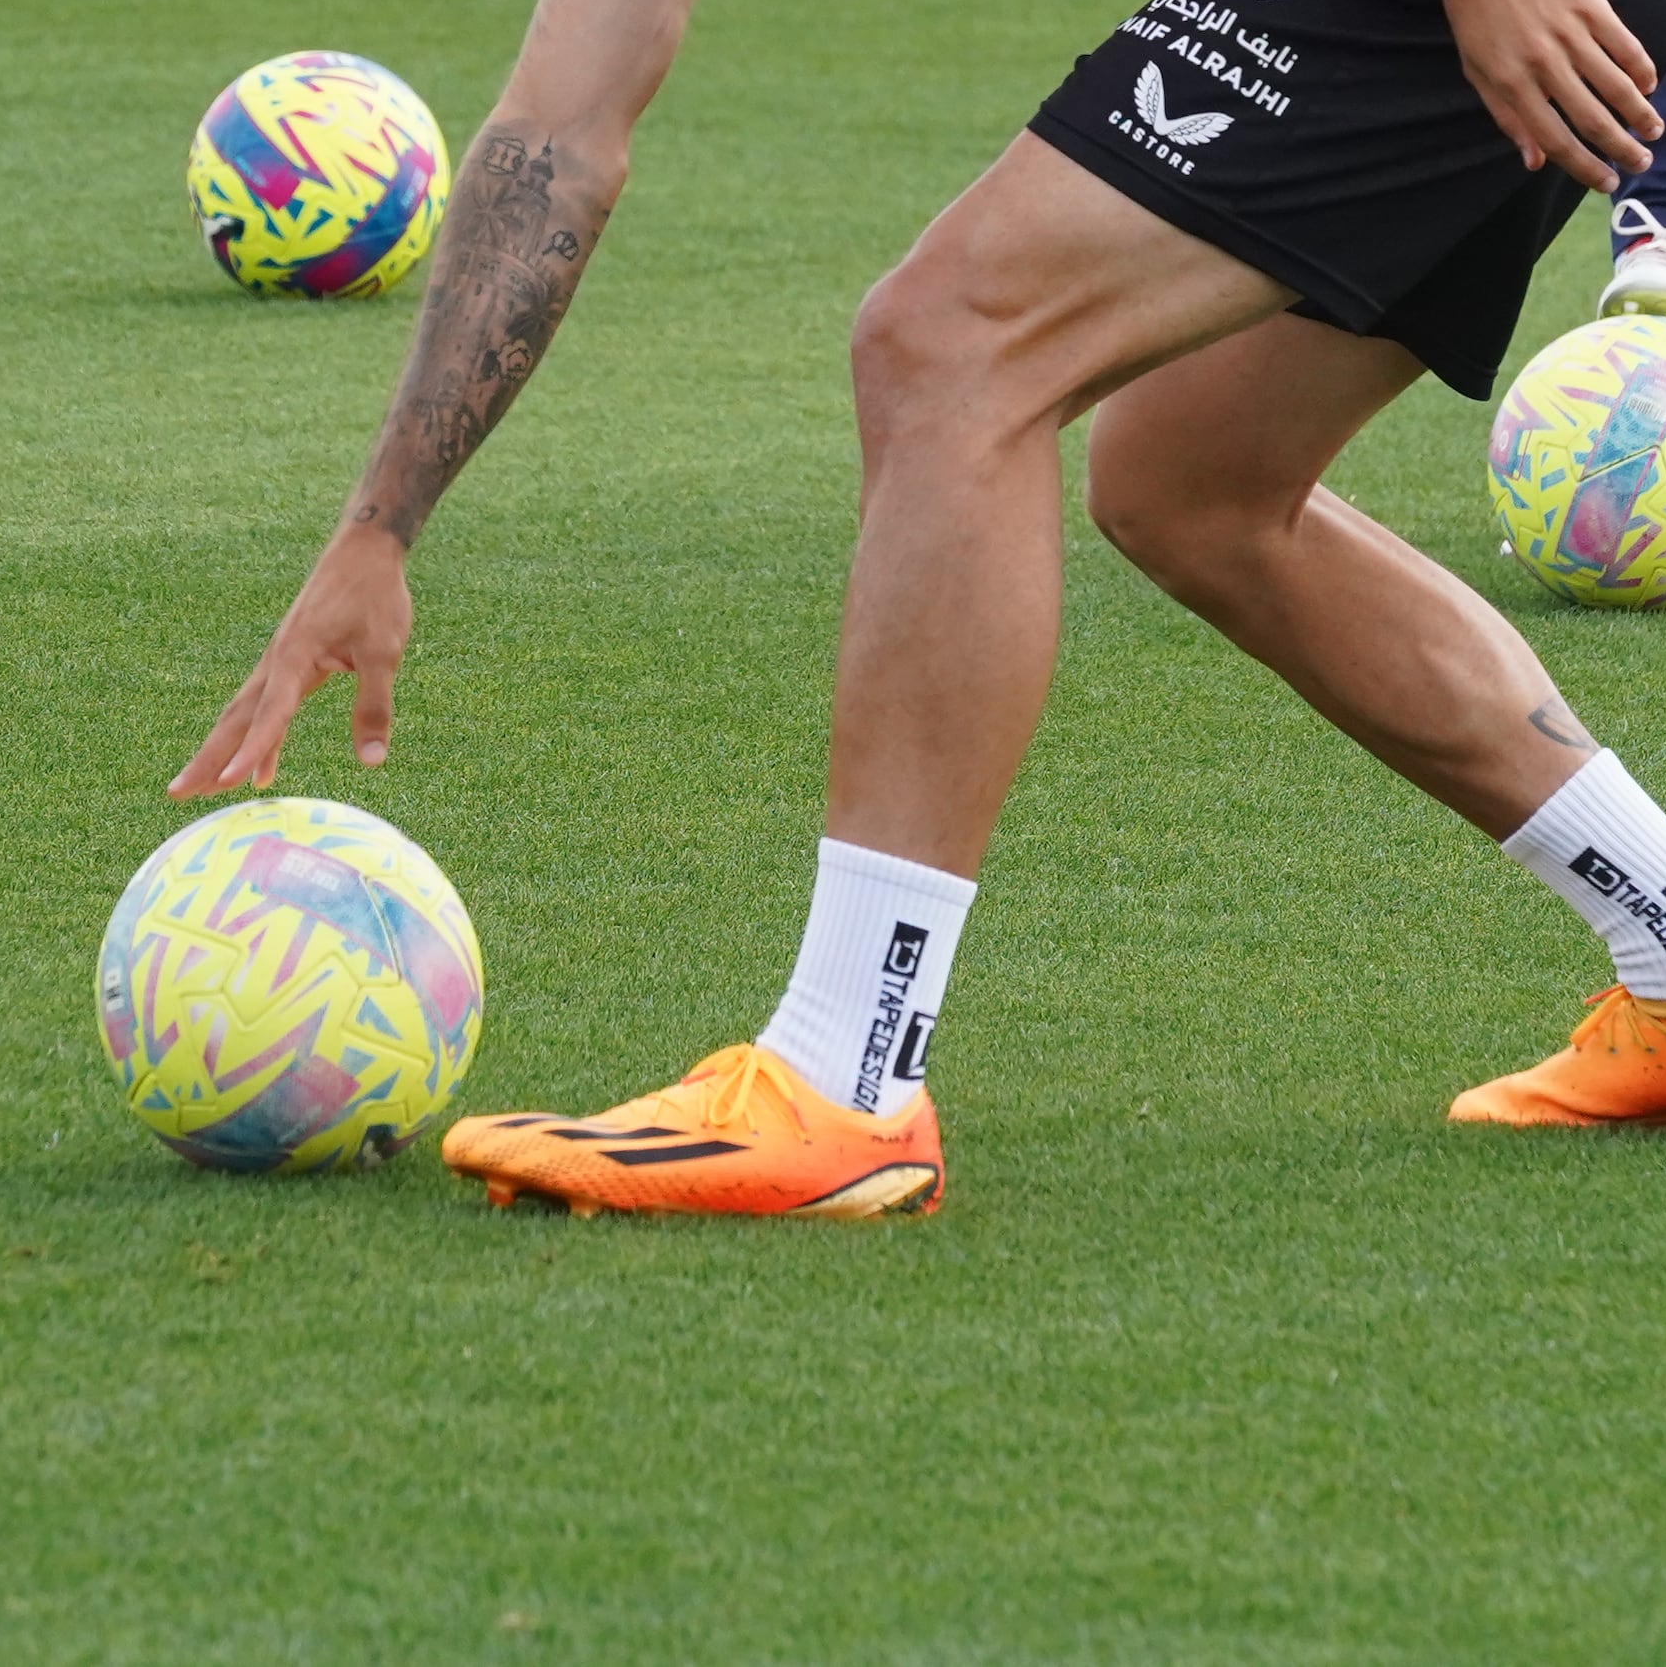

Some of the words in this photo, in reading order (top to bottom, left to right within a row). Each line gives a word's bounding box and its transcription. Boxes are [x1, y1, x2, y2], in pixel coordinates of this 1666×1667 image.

[1117, 16, 1171, 41] NAIF
[1167, 35, 1291, 117] ALRAJHI
[1236, 28, 1299, 74] نايف
[1108, 110, 1195, 175] CASTORE
